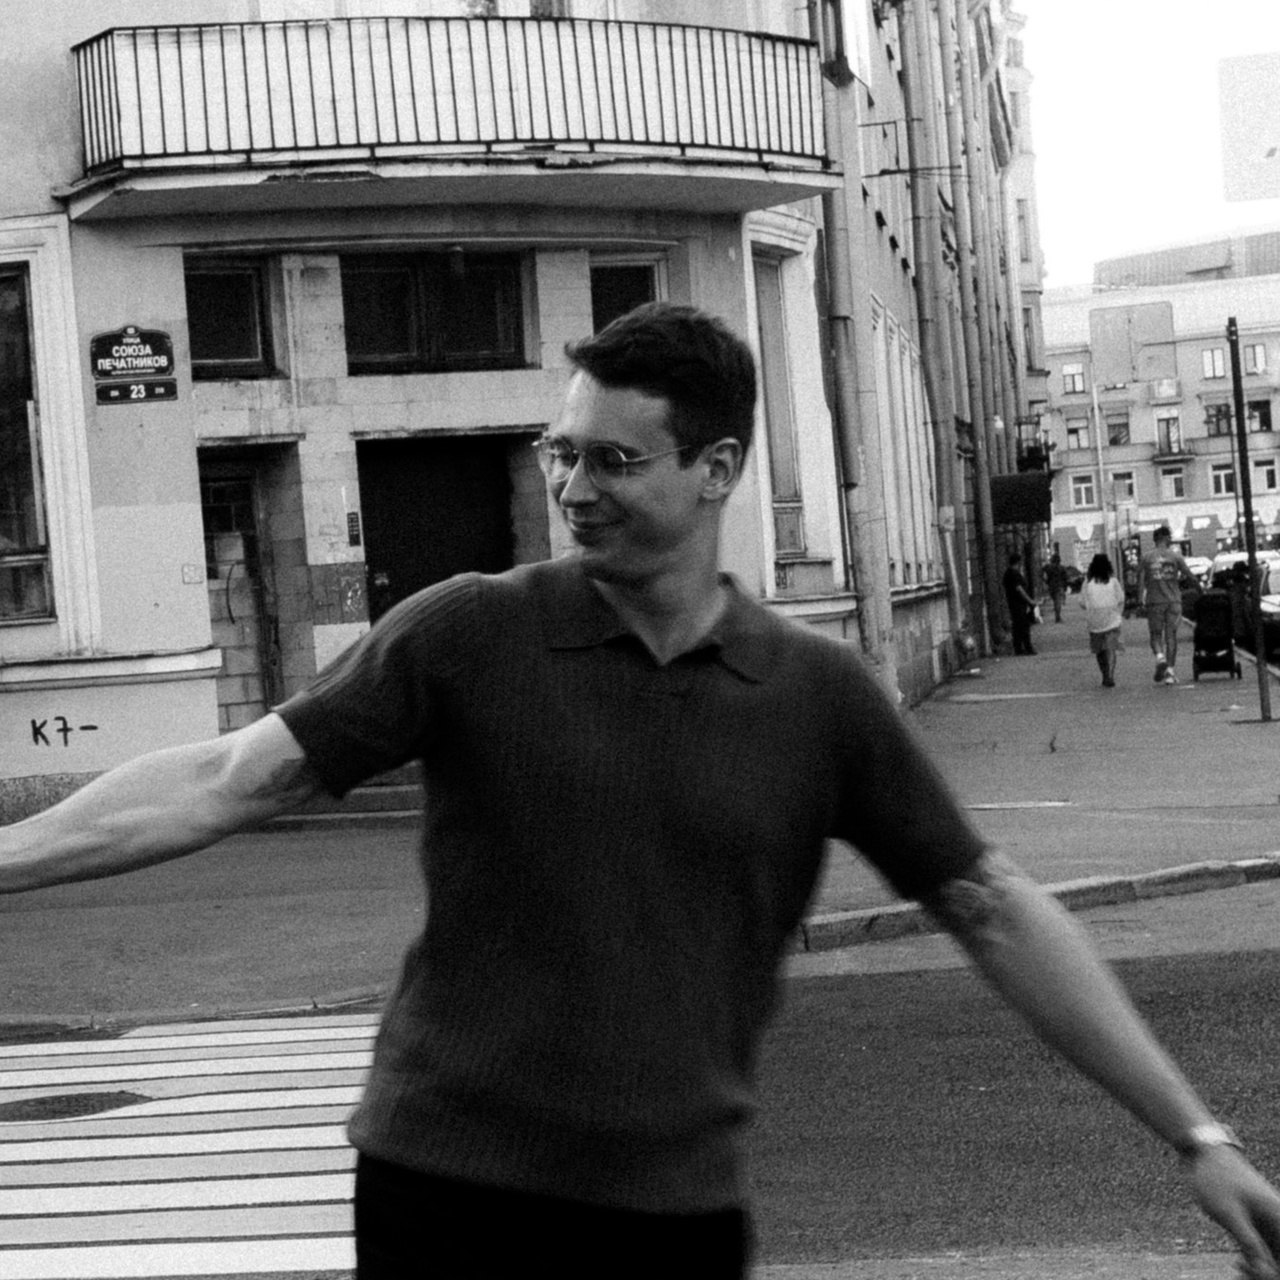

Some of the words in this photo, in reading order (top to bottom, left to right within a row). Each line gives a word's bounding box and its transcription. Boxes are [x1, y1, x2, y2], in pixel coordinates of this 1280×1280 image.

[112, 344, 152, 357] СОЮЗА
[97, 355, 168, 370] ПЕЧАТНИКОВ
[130, 384, 146, 398] 23
